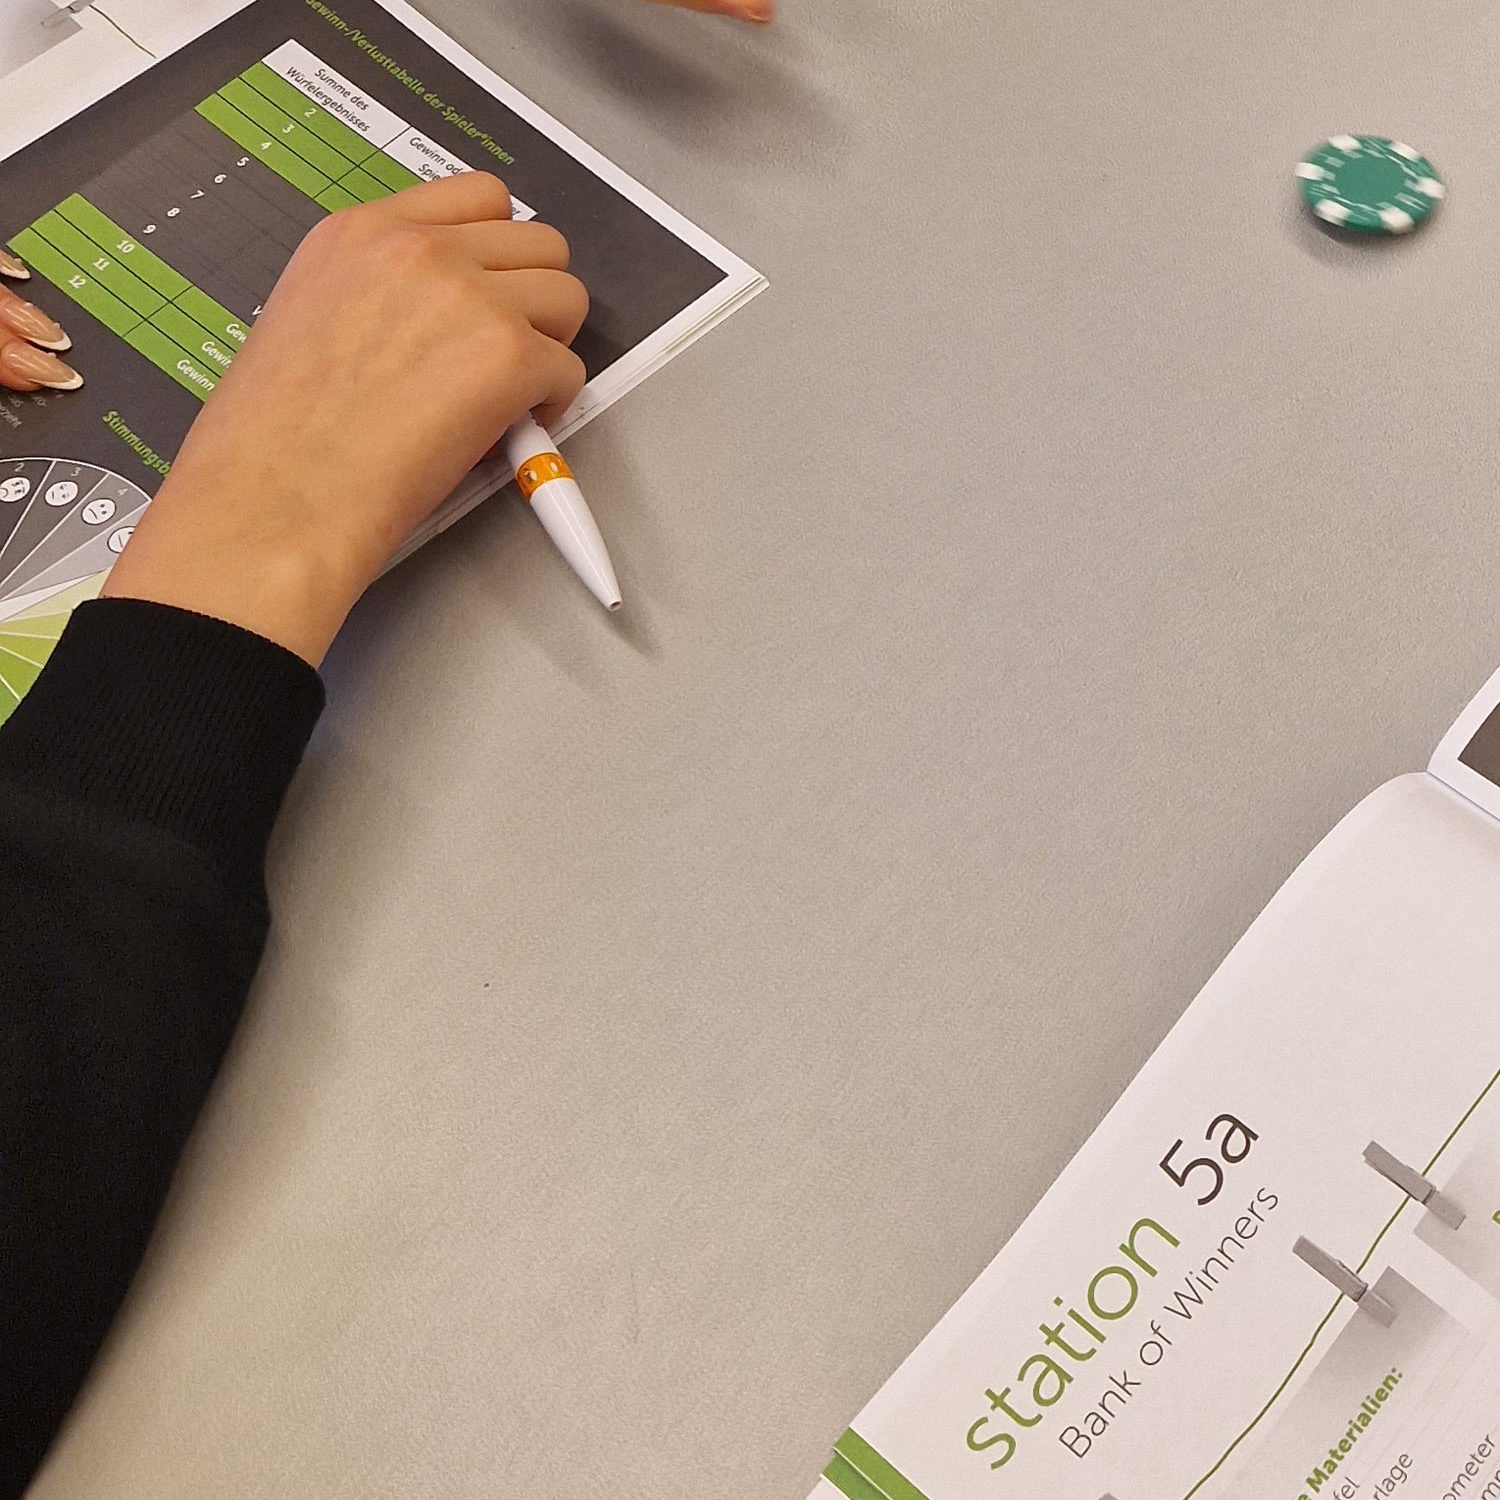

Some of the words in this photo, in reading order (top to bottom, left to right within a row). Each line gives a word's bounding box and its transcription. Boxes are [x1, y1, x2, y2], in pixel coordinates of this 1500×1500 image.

[314, 67, 353, 100] Summe
[350, 93, 370, 112] des
[285, 65, 371, 133] Würfelergebnisses
[423, 91, 445, 111] der
[304, 107, 317, 118] 2
[282, 124, 294, 134] 3
[260, 139, 272, 151] 4
[409, 136, 448, 167] Gewinn
[236, 156, 250, 168] 5
[214, 173, 227, 184] 6
[190, 190, 204, 200] 7
[167, 207, 180, 218] 8
[143, 224, 156, 235] 9
[117, 239, 135, 254] 10
[93, 257, 111, 272] 11
[68, 275, 86, 290] 12
[176, 358, 215, 392] Gewinn
[103, 410, 172, 477] Stimmungsb
[965, 1217, 1181, 1471] station
[1158, 1112, 1260, 1207] 5a
[1058, 1369, 1142, 1459] Bank
[1139, 1320, 1173, 1366] of
[1163, 1186, 1279, 1321] Winners
[1305, 1366, 1404, 1494] Materialien:
